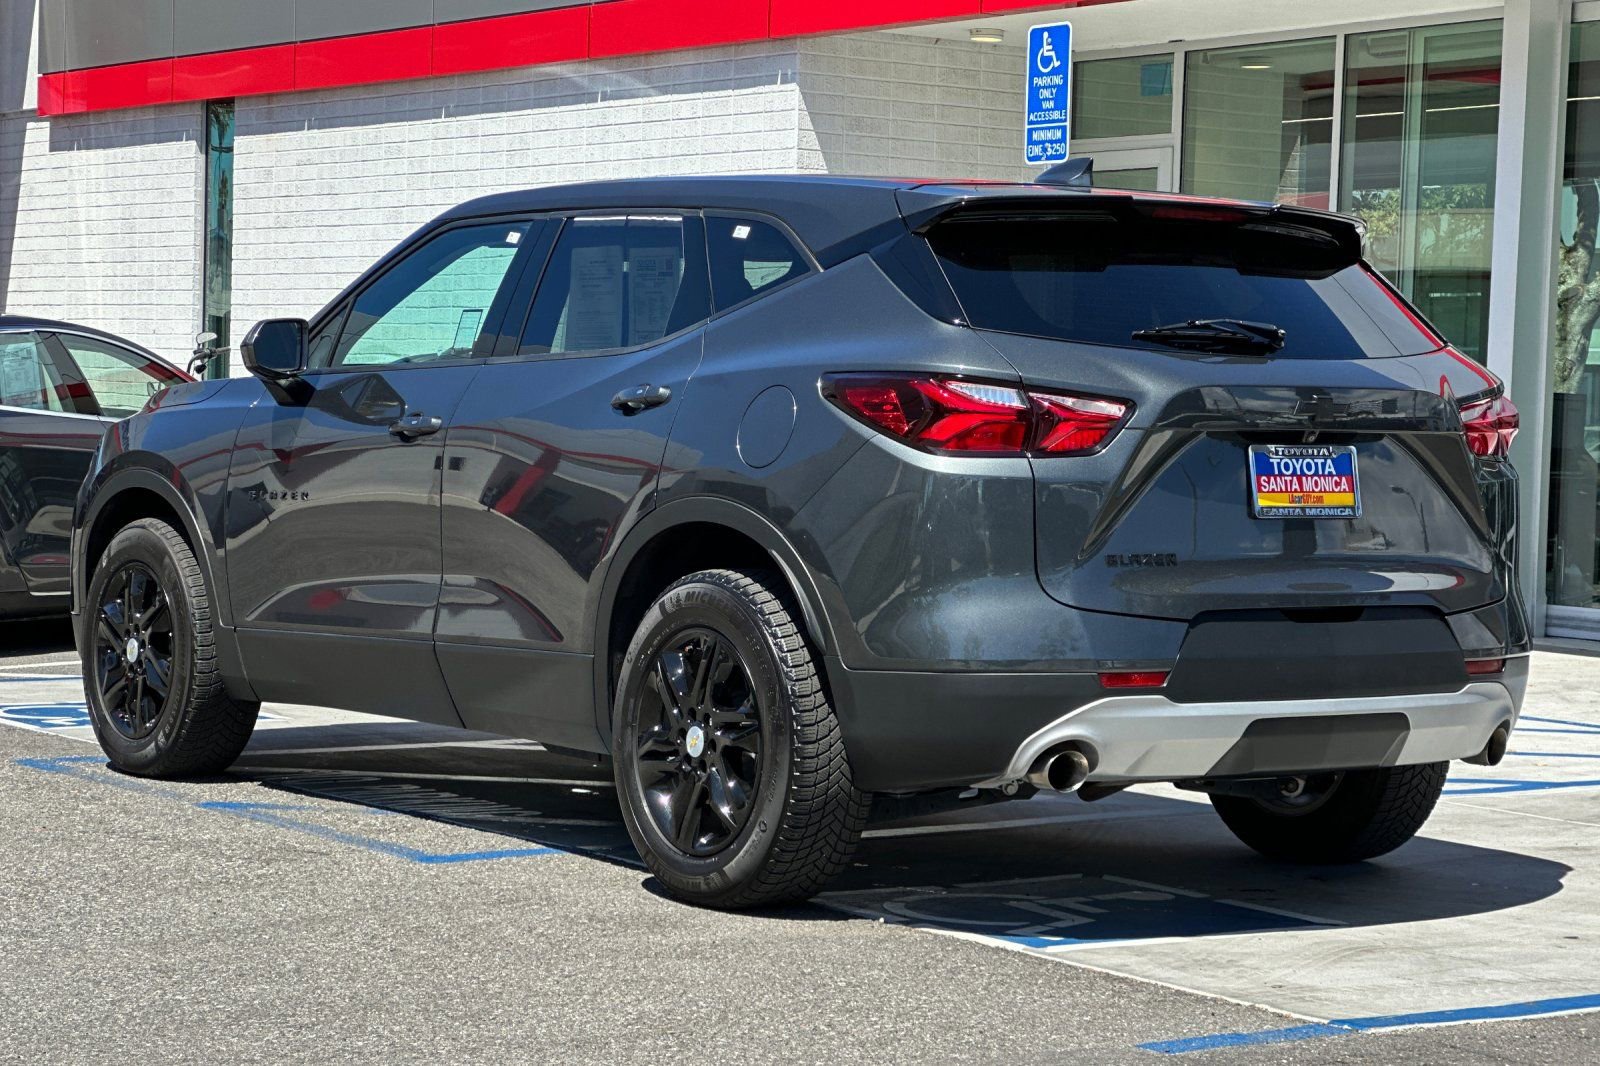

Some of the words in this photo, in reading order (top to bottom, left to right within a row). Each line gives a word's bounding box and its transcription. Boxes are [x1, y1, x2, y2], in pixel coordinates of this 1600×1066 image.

[1034, 75, 1063, 86] PARKING
[1038, 87, 1057, 99] ONLY
[1042, 100, 1054, 109] VAN
[1029, 110, 1065, 121] ACCESSIBLE
[1032, 128, 1062, 141] MINIMUM
[1275, 447, 1330, 456] TOYOTA
[1269, 458, 1337, 475] TOYOTA
[1260, 476, 1301, 492] SANTA
[1302, 476, 1349, 492] MONICA
[1263, 508, 1304, 516] SANTA
[1305, 508, 1354, 516] MONICA
